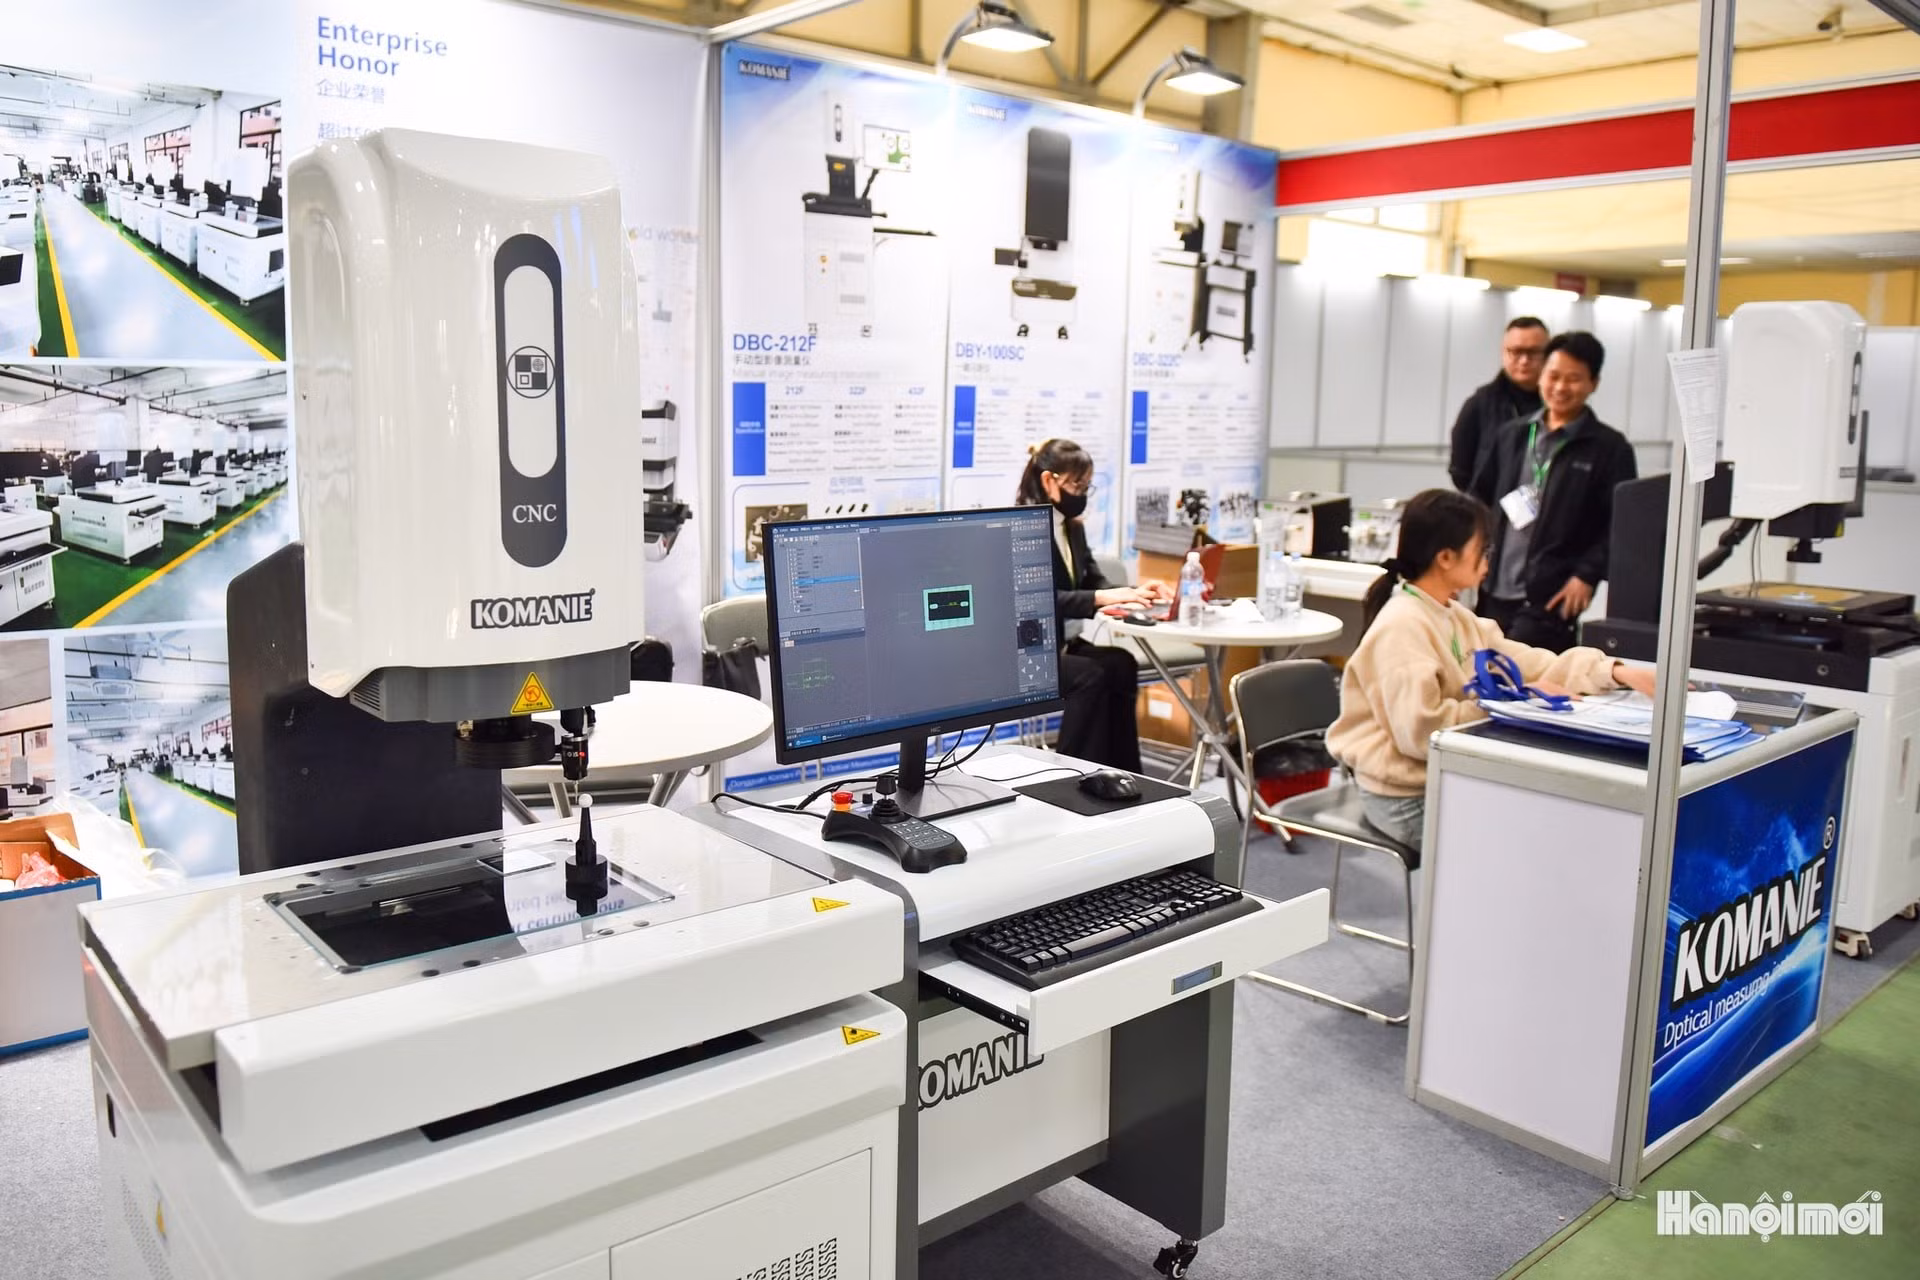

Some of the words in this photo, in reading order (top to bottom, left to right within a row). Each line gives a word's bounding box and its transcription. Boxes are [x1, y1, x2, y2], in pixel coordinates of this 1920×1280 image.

[318, 16, 448, 57] Enterprise
[318, 45, 400, 76] Honor
[733, 334, 817, 351] DBC-212F
[955, 342, 1025, 360] DBY-100SC
[512, 504, 557, 523] CNC
[471, 593, 592, 629] KOMANIE
[1672, 856, 1826, 1003] KOMANIE
[918, 1031, 1044, 1111] OMANI
